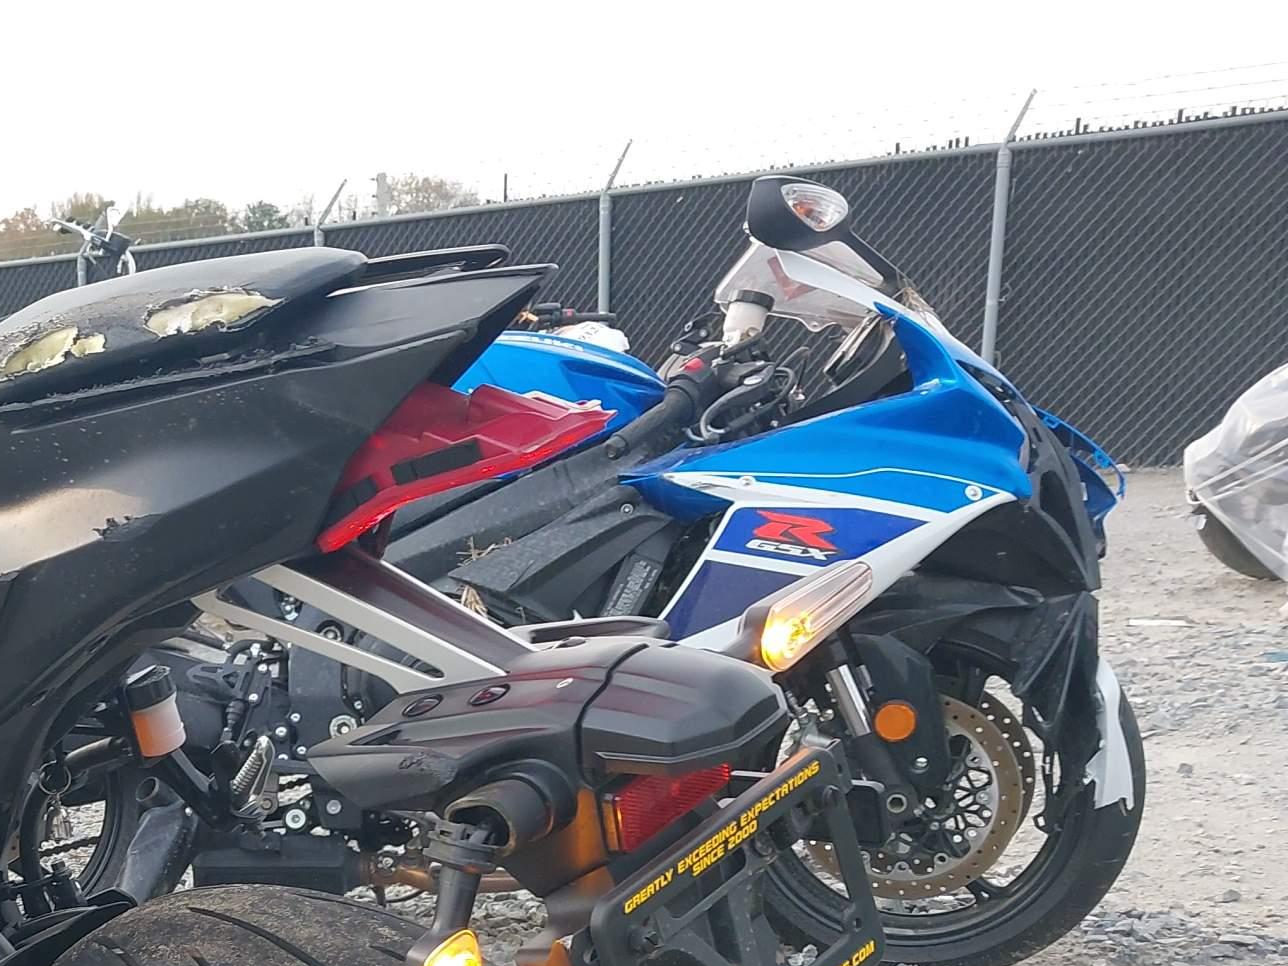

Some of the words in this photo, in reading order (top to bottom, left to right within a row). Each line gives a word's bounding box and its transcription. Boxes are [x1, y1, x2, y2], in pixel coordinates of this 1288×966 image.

[745, 539, 838, 561] GSX
[624, 868, 674, 914] GREATLY
[677, 821, 738, 874] EXCEEDING
[740, 760, 821, 827] EXPECTATIONS
[692, 845, 726, 876] SINCE
[727, 819, 758, 849] 2000
